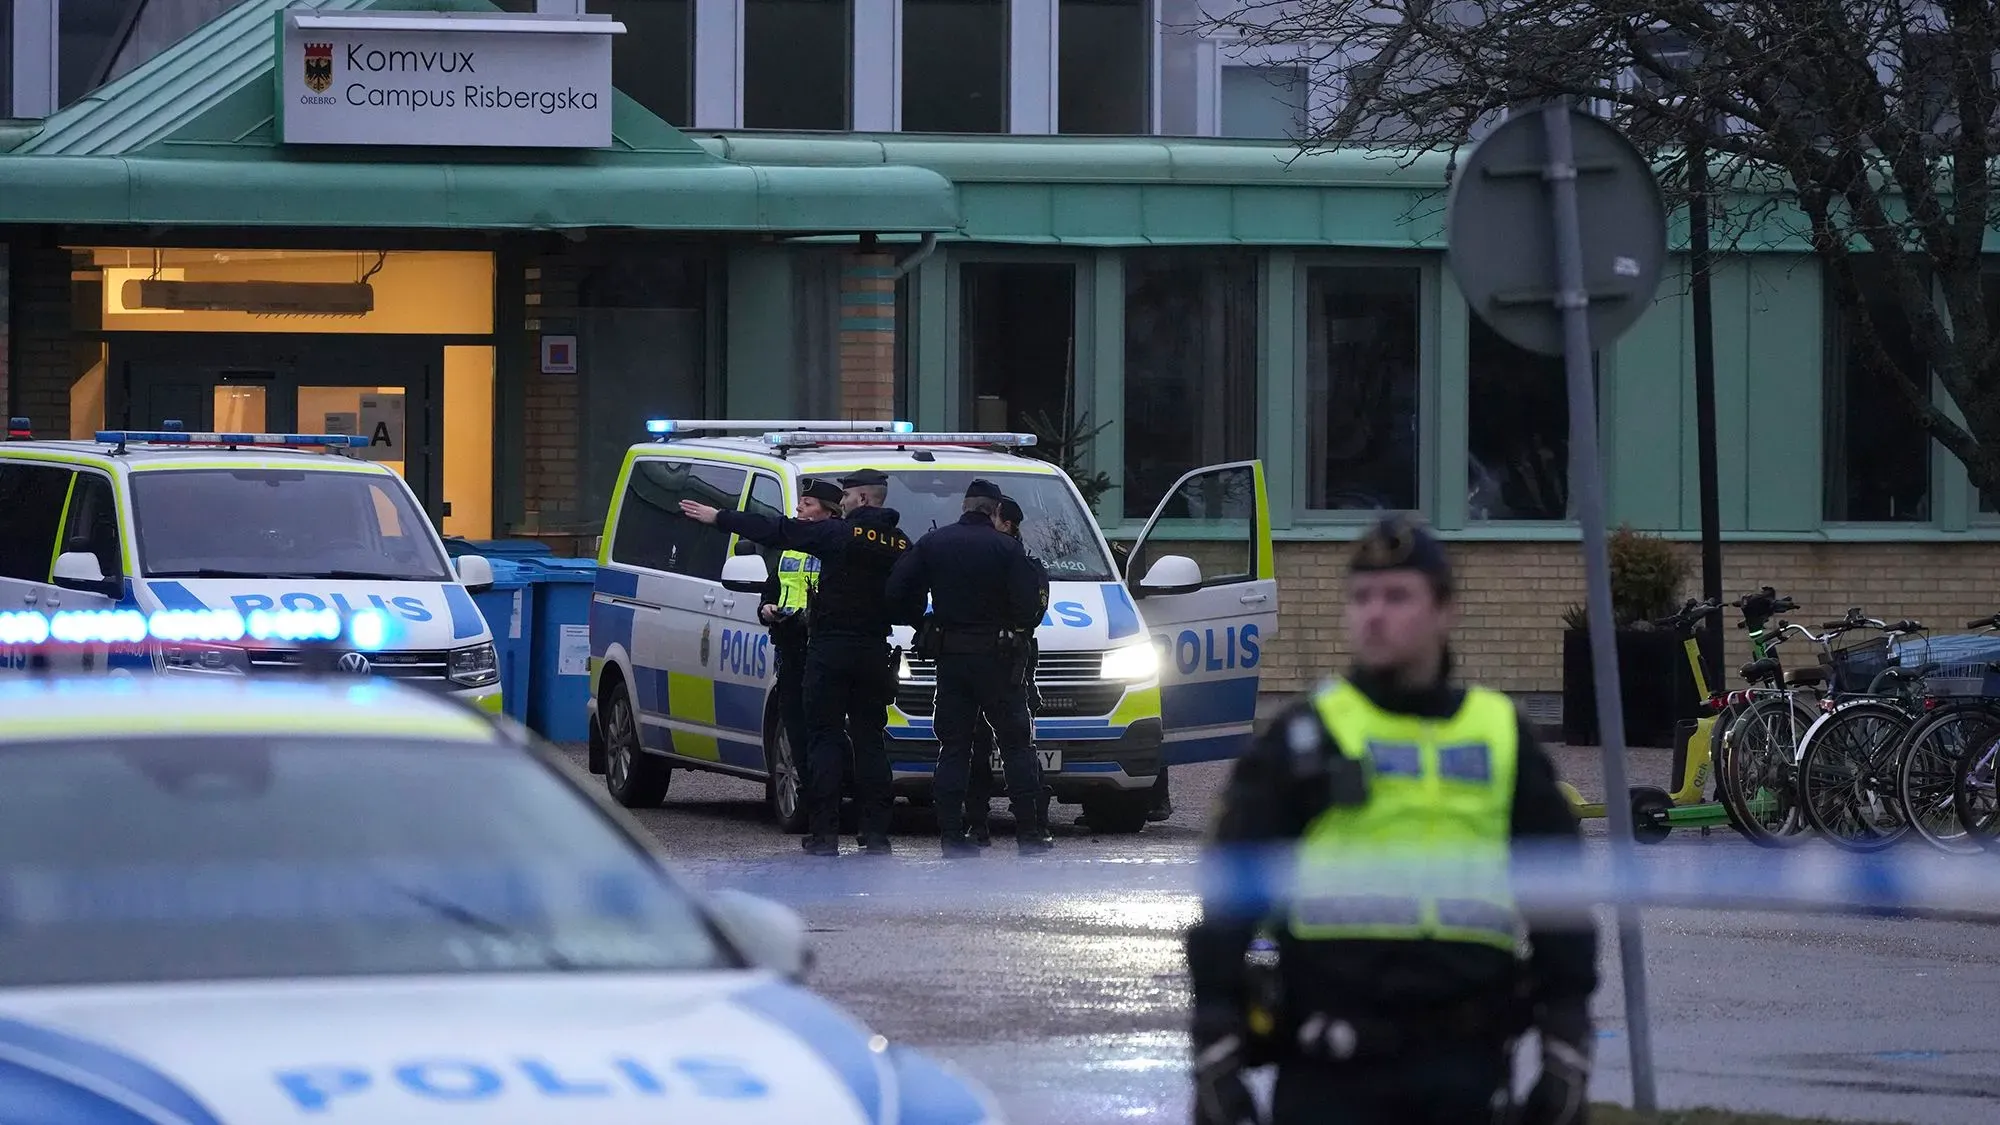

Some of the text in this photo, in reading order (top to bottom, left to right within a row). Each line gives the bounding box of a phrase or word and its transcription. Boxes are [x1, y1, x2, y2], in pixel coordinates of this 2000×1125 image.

[347, 43, 475, 73] Komvux
[300, 94, 337, 105] ÖREBRO
[346, 83, 597, 114] Campus Risbergska
[371, 421, 392, 447] A
[853, 527, 907, 550] POLIS
[1041, 559, 1086, 571] 3-1420
[720, 628, 768, 680] POLIS
[274, 1056, 770, 1113] POLIS
